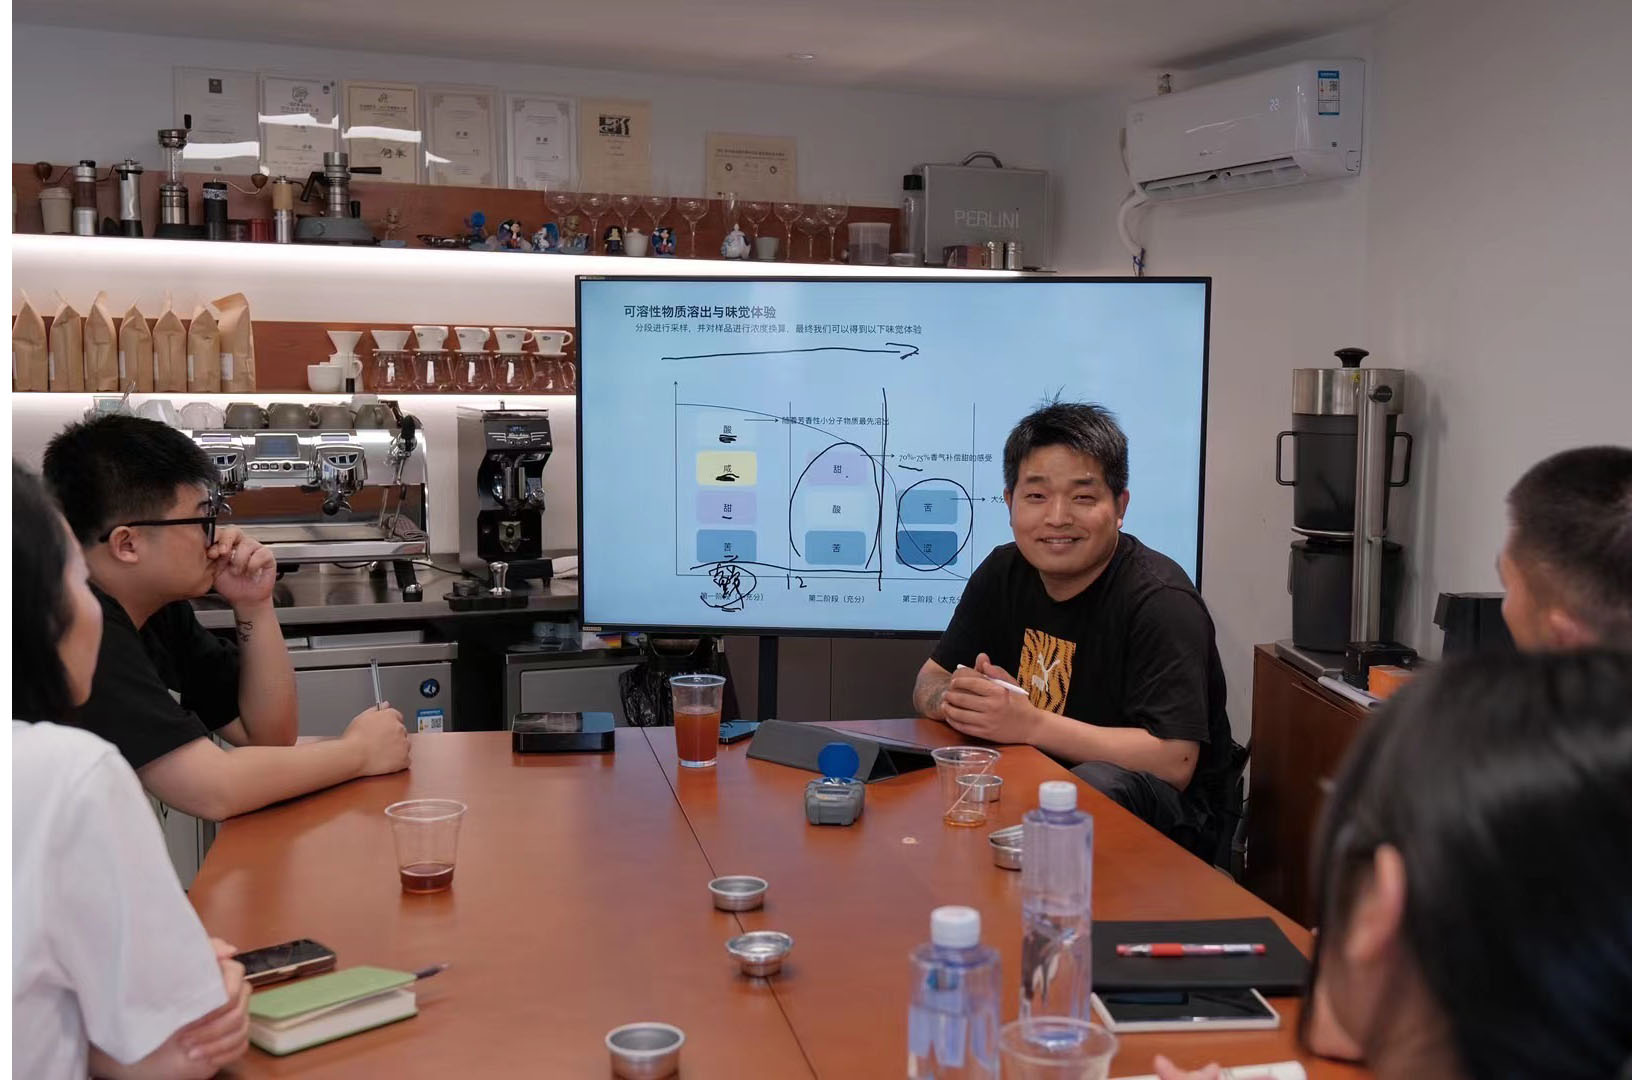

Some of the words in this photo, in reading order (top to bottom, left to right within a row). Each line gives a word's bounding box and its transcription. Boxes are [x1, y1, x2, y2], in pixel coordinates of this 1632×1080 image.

[624, 305, 776, 319] 可溶性物质溶出与味觉体验
[723, 425, 732, 434] 酸
[723, 464, 732, 473] 咸
[833, 465, 842, 474] 甜
[723, 503, 732, 513] 甜
[832, 505, 841, 514] 酸
[924, 503, 933, 513] 苦
[723, 543, 732, 552] 苦
[832, 543, 841, 553] 苦
